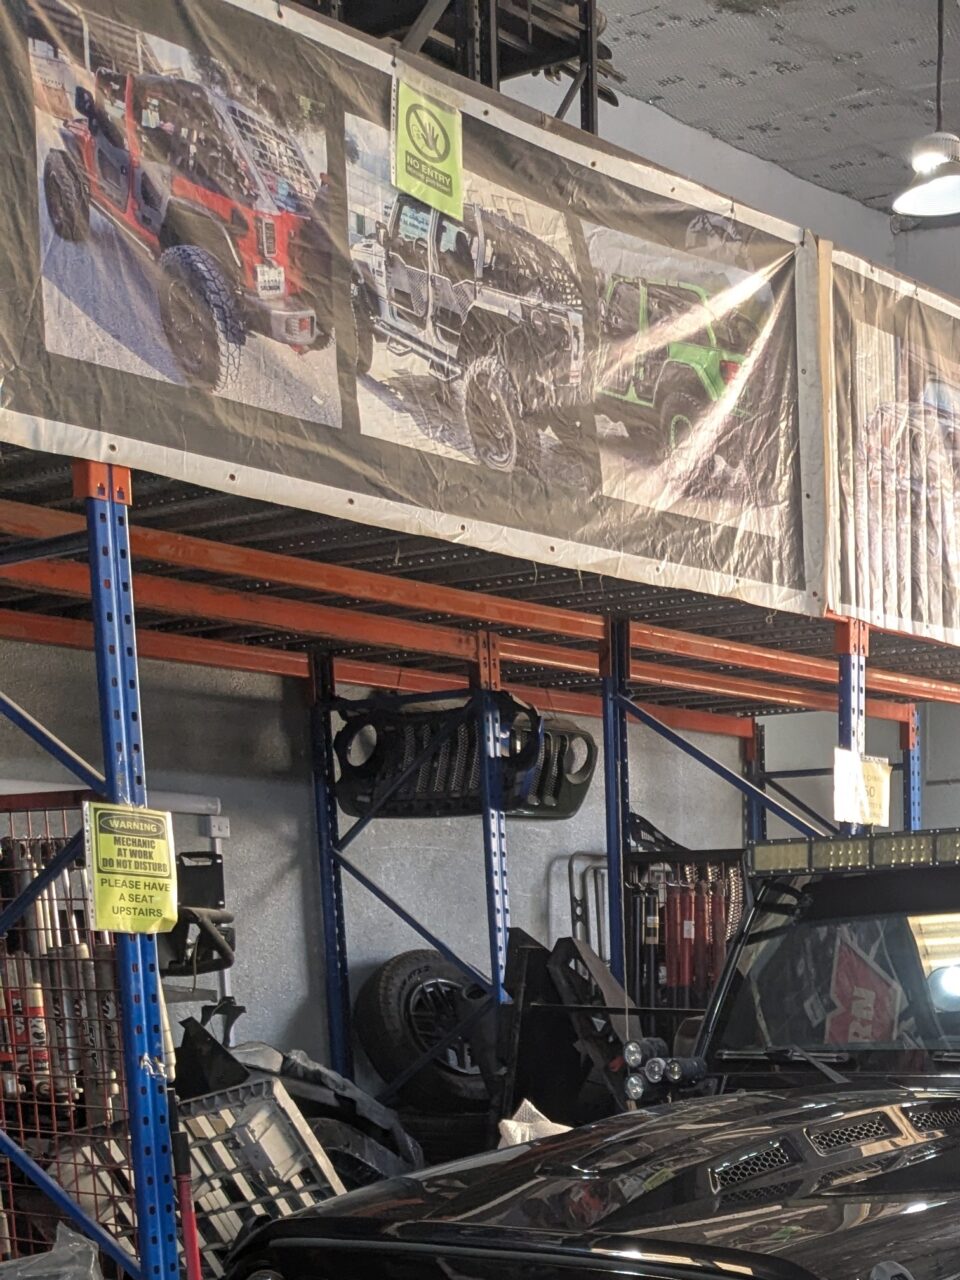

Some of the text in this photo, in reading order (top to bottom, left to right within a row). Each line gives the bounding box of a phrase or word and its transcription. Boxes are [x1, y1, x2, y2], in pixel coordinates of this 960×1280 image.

[407, 154, 420, 169] NO
[421, 164, 451, 186] ENTRY
[109, 818, 158, 832] WARNING
[113, 836, 156, 849] MECHANIC
[117, 848, 154, 860] AT WORK
[102, 858, 168, 873] DO NOT DISTURB
[100, 878, 171, 892] PLEASE HAVE
[118, 893, 155, 903] A SEAT
[111, 906, 163, 918] UPSTAIRS
